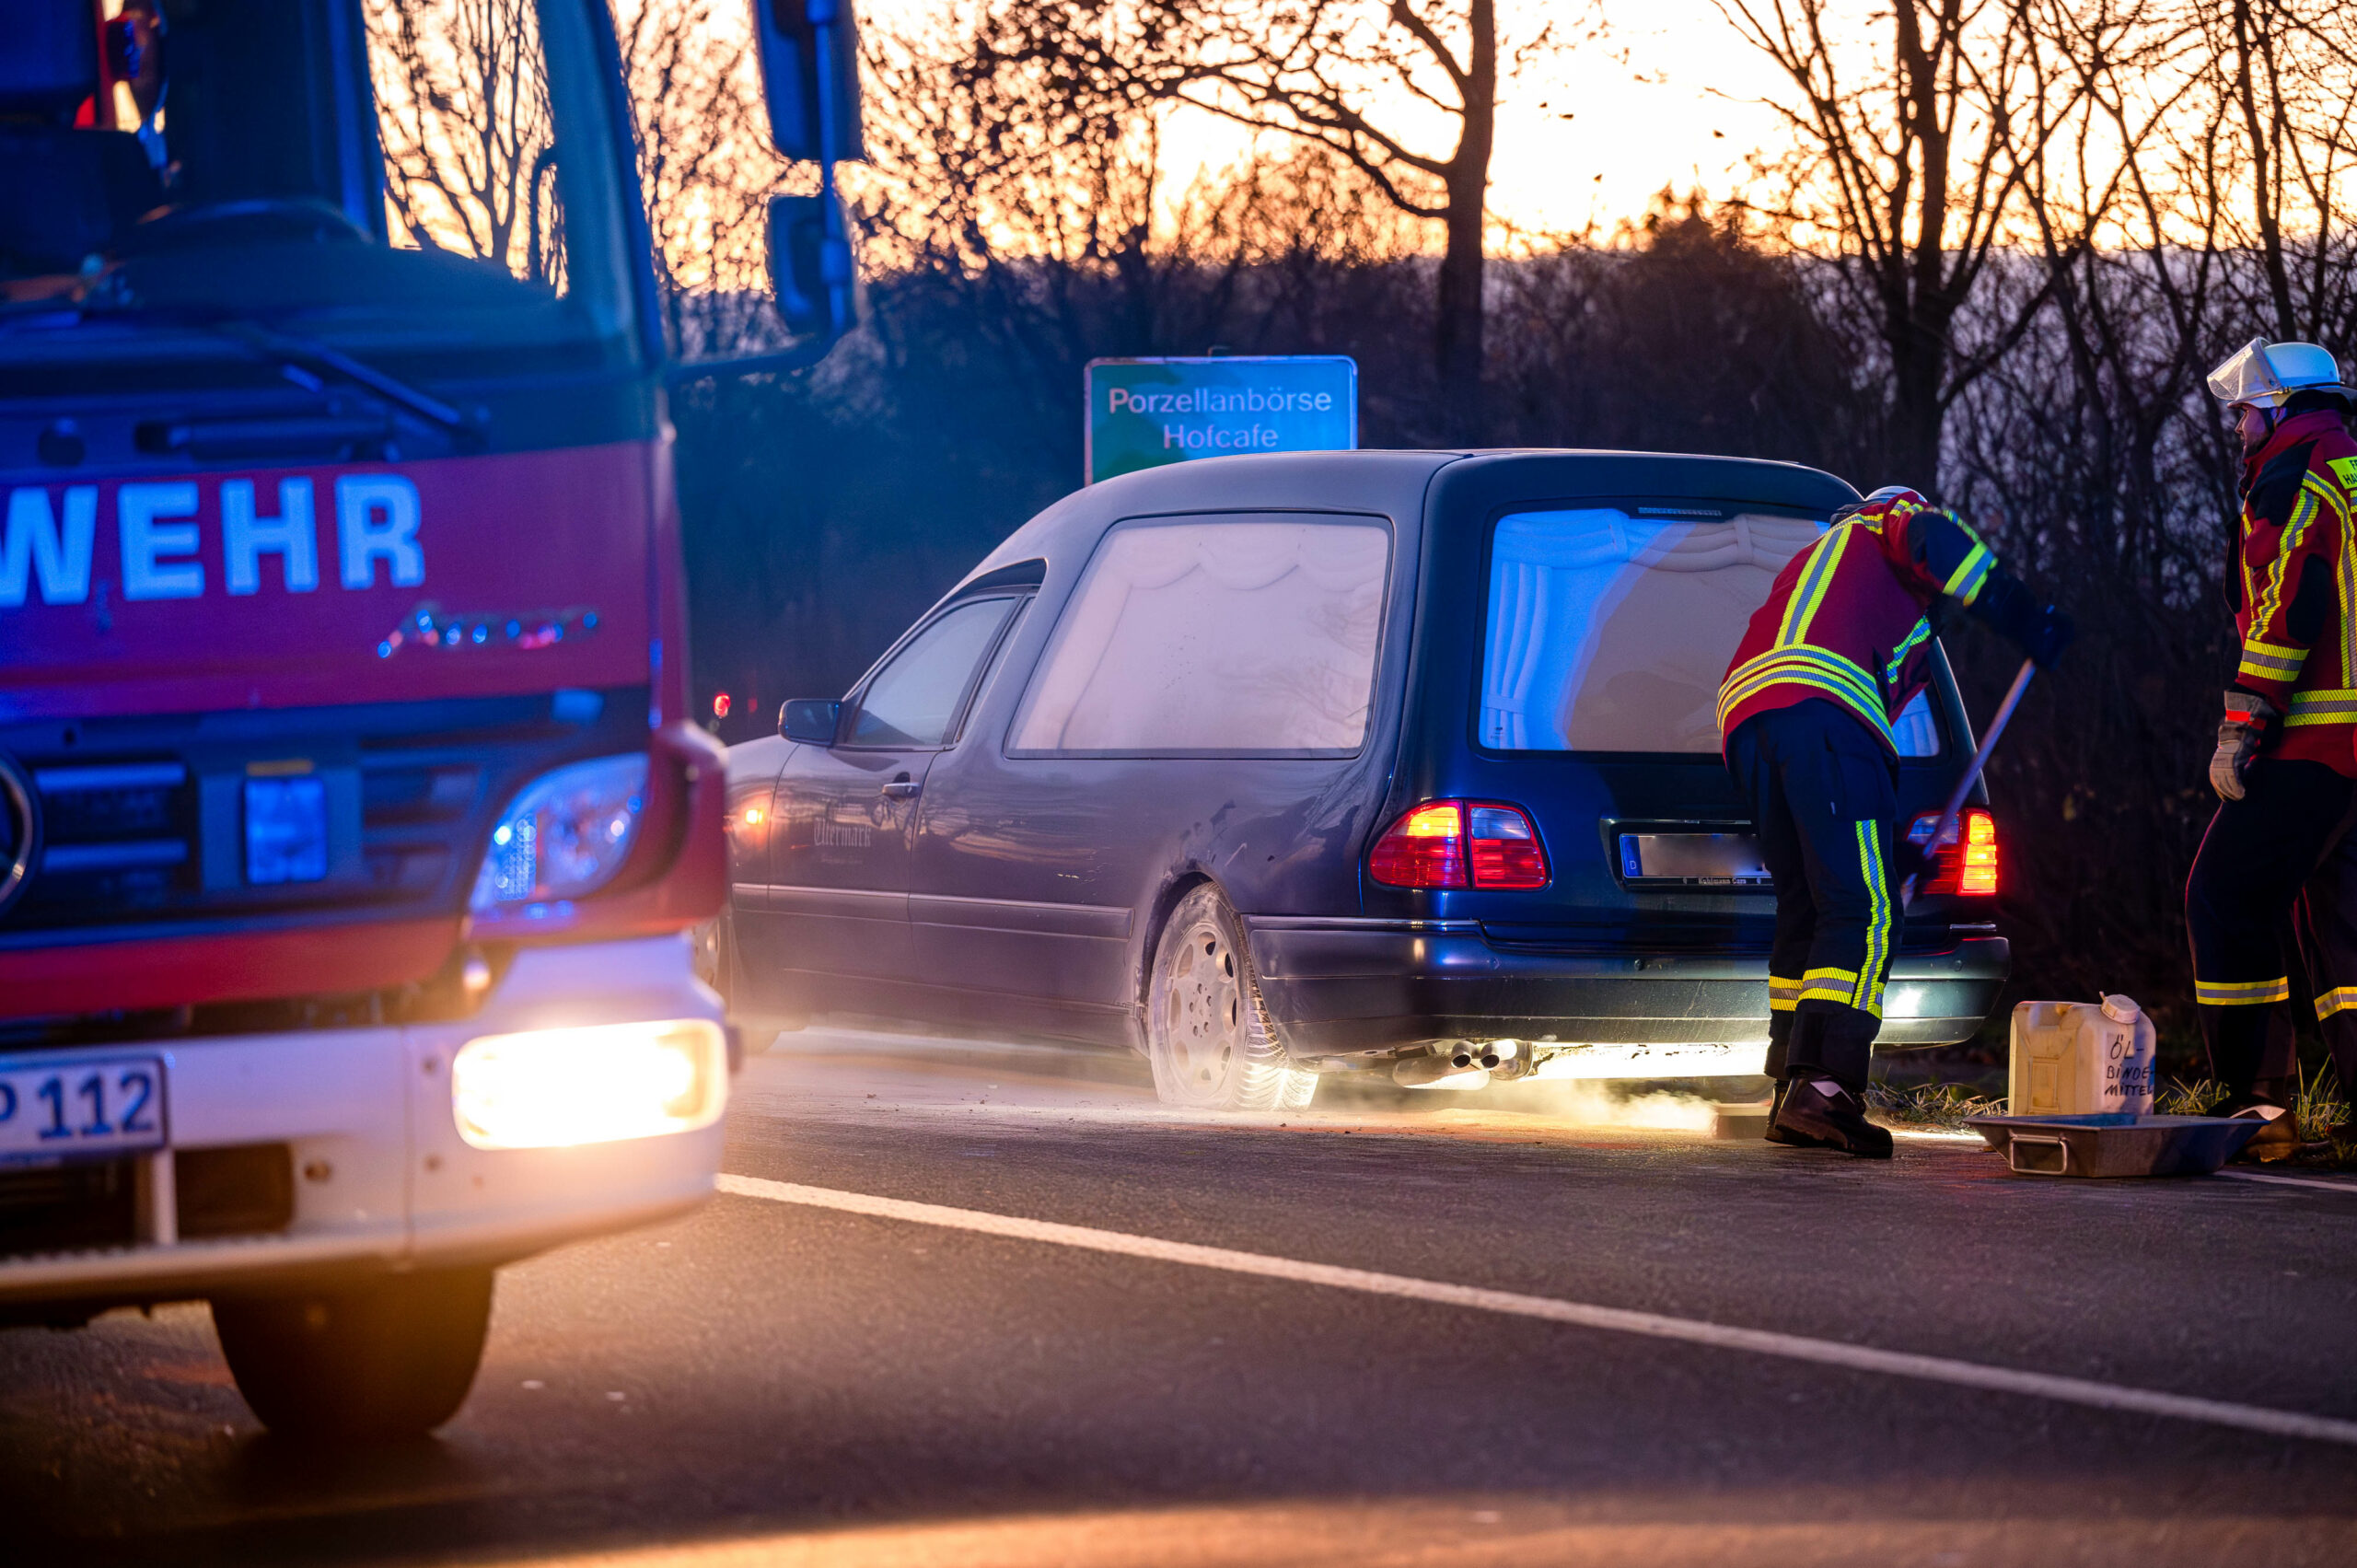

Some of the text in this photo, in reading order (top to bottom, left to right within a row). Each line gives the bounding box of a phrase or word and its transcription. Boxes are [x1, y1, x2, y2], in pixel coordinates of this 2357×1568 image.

[1109, 386, 1331, 413] Porzellanbörse
[1163, 424, 1279, 449] Hofcafe
[2341, 472, 2357, 485] HA
[0, 472, 426, 608] WEHR
[1630, 860, 1637, 870] D
[2110, 1033, 2144, 1060] ÖL-
[38, 1073, 153, 1140] 112
